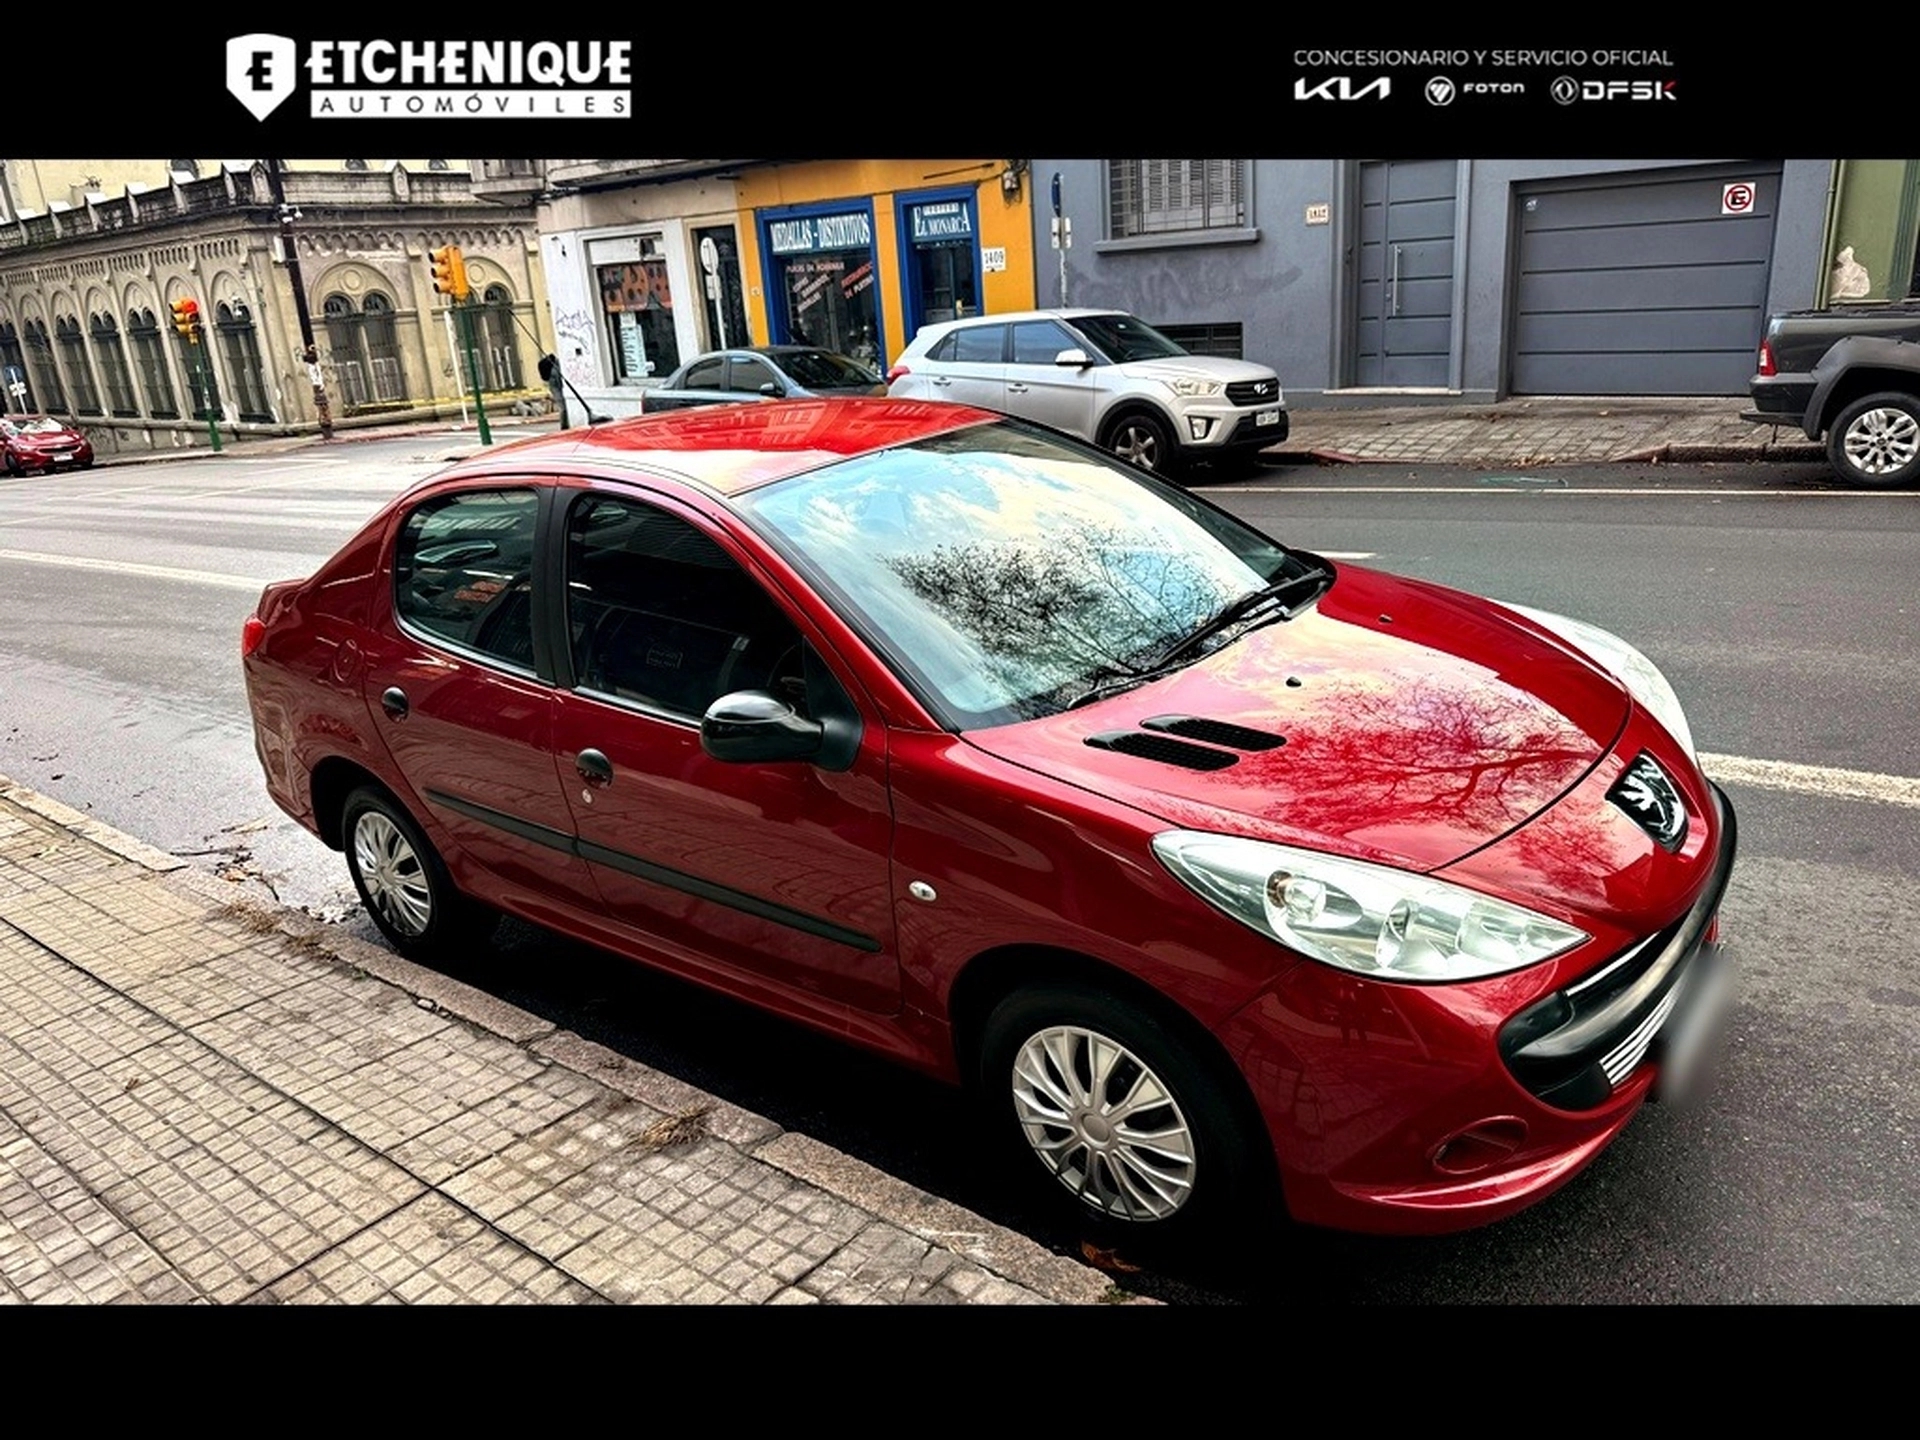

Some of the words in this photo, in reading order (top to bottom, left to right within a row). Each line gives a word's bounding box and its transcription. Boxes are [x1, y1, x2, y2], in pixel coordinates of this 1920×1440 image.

[770, 219, 812, 252] MEDALLAS
[817, 213, 870, 248] DISTINTIVOS
[984, 251, 1004, 264] 1409
